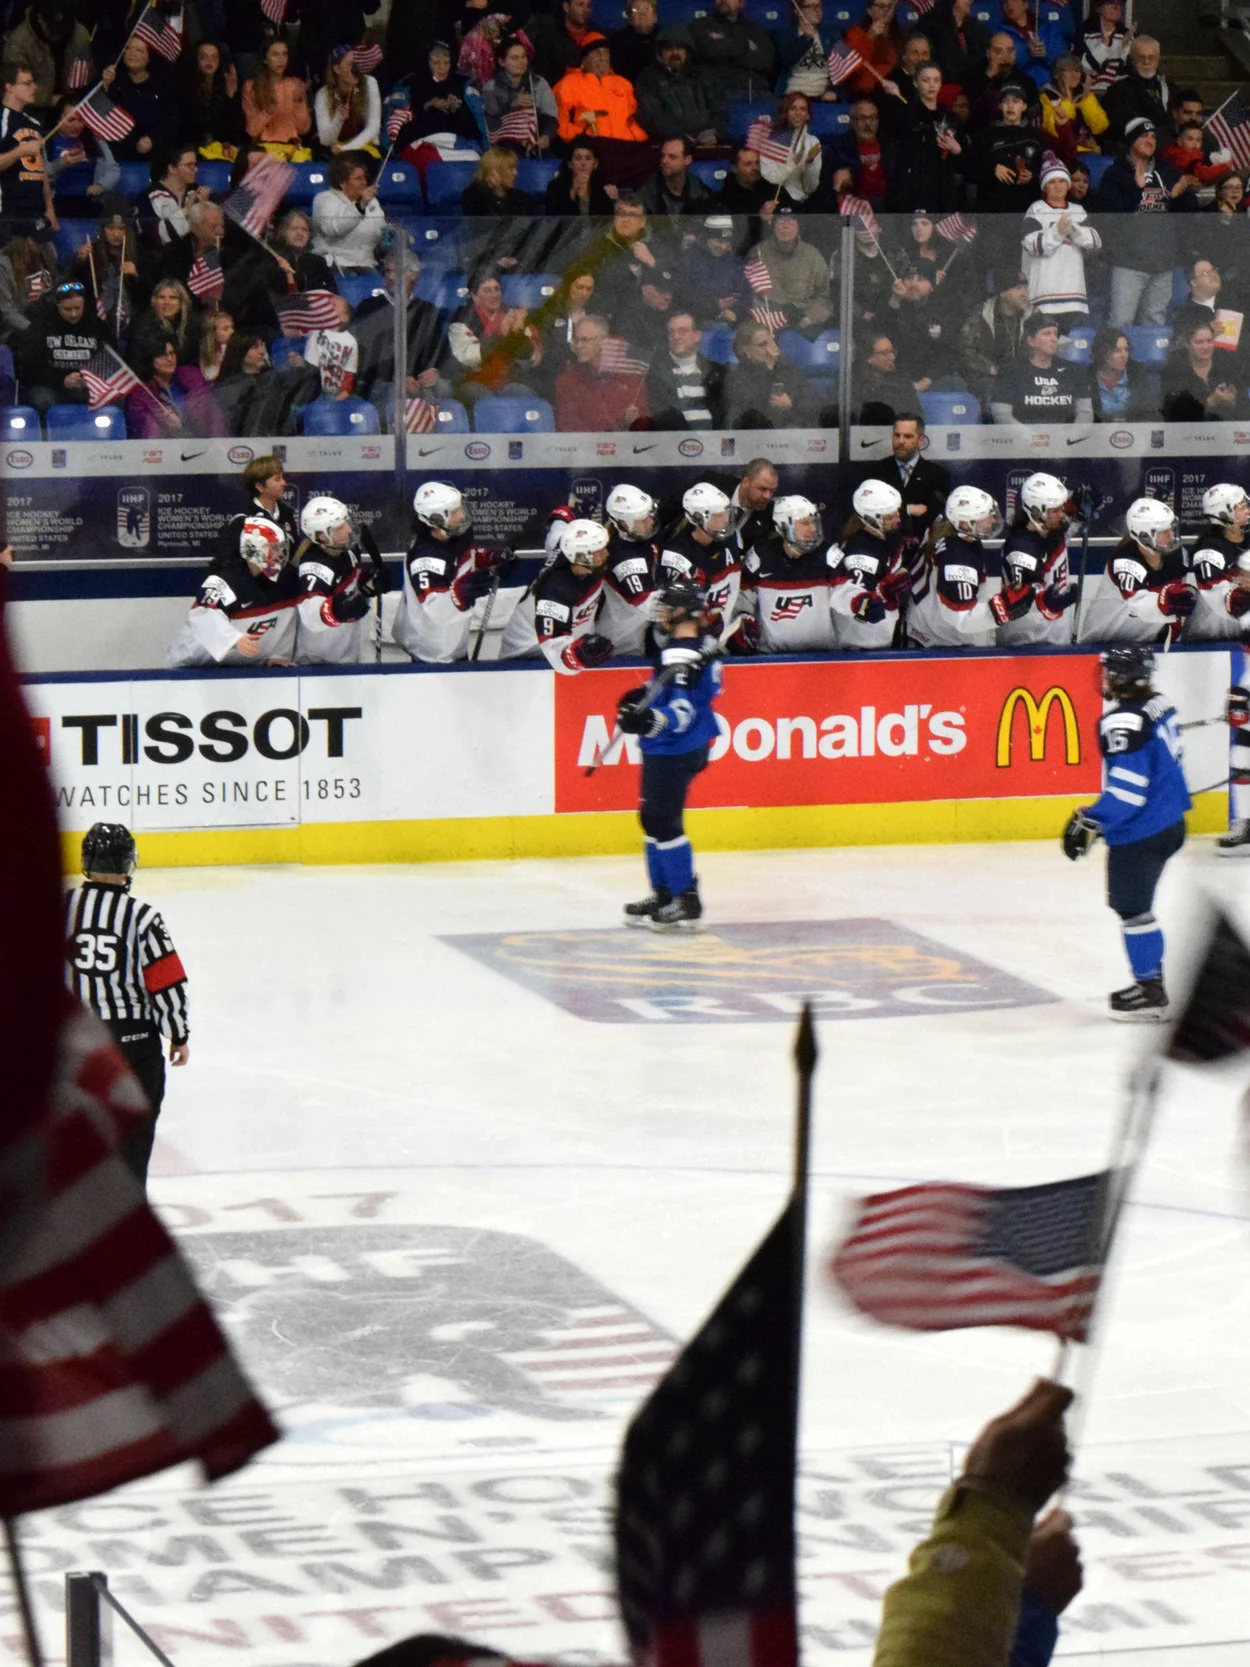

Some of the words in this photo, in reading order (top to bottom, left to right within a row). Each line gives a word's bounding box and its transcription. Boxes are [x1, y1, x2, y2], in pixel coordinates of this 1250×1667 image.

[1034, 376, 1059, 386] USA
[1024, 395, 1073, 406] HOCKEY
[1150, 475, 1171, 484] IIHF
[1182, 474, 1206, 484] 2017
[464, 487, 488, 497] 2017
[576, 485, 598, 494] IIHF
[1182, 487, 1195, 495] ICE
[7, 497, 32, 506] 2017
[122, 494, 145, 504] IIHF
[158, 493, 183, 503] 2017
[480, 501, 516, 509] HOCKEY
[23, 511, 60, 519] HOCKEY
[158, 507, 172, 515] ICE
[174, 507, 211, 515] HOCKEY
[471, 509, 505, 517] OMEN'S
[506, 508, 537, 516] WORLD
[51, 517, 83, 526] WORLD
[202, 514, 233, 523] WORLD
[158, 521, 225, 530] CHAMPIONSHIP
[494, 524, 523, 532] STATES
[38, 534, 69, 542] STATES
[158, 531, 188, 539] UNITED
[189, 531, 219, 539] STATES
[306, 574, 317, 592] 7
[419, 571, 430, 590] 5
[626, 574, 644, 594] 19
[957, 582, 973, 601] 10
[773, 594, 814, 617] USA
[543, 618, 554, 636] 9
[61, 707, 363, 766] TISSOT
[58, 783, 189, 807] WATCHES
[202, 780, 286, 804] SINCE
[302, 777, 363, 800] 1853
[75, 934, 118, 971] 35
[121, 1032, 149, 1043] CCM
